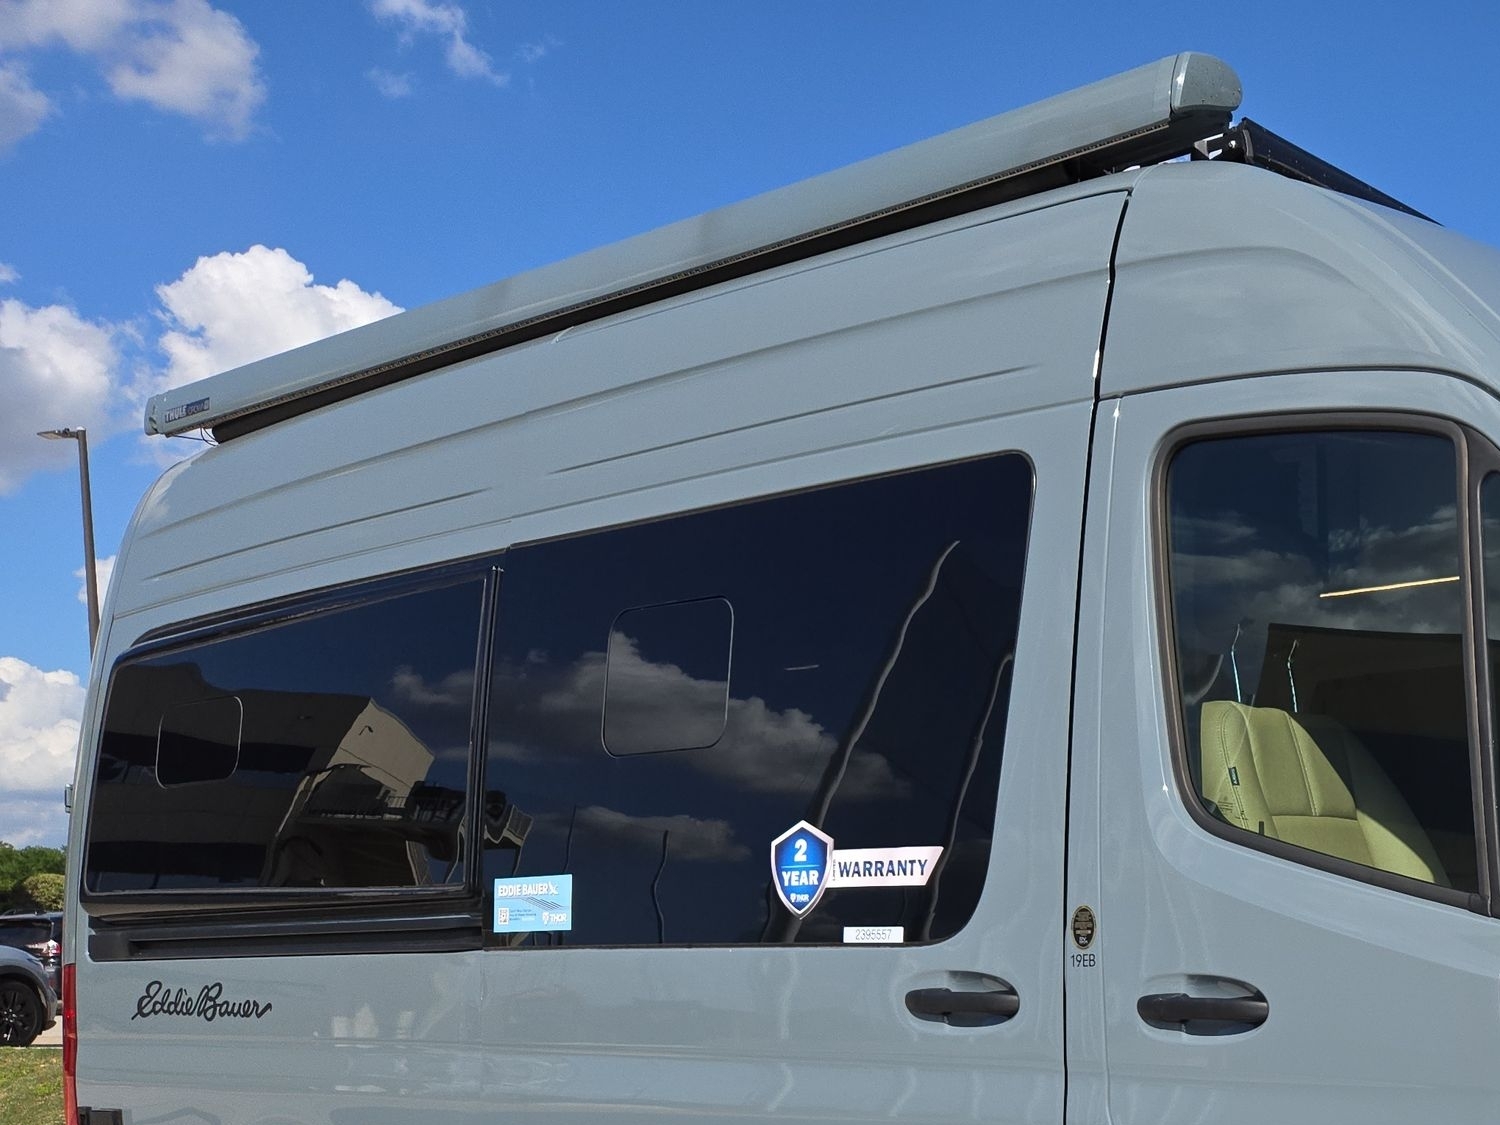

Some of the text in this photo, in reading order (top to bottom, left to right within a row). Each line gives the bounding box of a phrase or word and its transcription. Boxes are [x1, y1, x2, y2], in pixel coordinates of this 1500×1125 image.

[165, 404, 187, 422] THULE
[793, 838, 808, 862] 2
[838, 858, 929, 878] WARRANTY
[781, 869, 819, 887] YEAR
[498, 882, 549, 897] EDDIE BAUER
[550, 913, 567, 922] THOR
[855, 928, 892, 940] 2395557
[1071, 953, 1096, 968] 19EB
[131, 980, 273, 1022] Eddie Bauer
